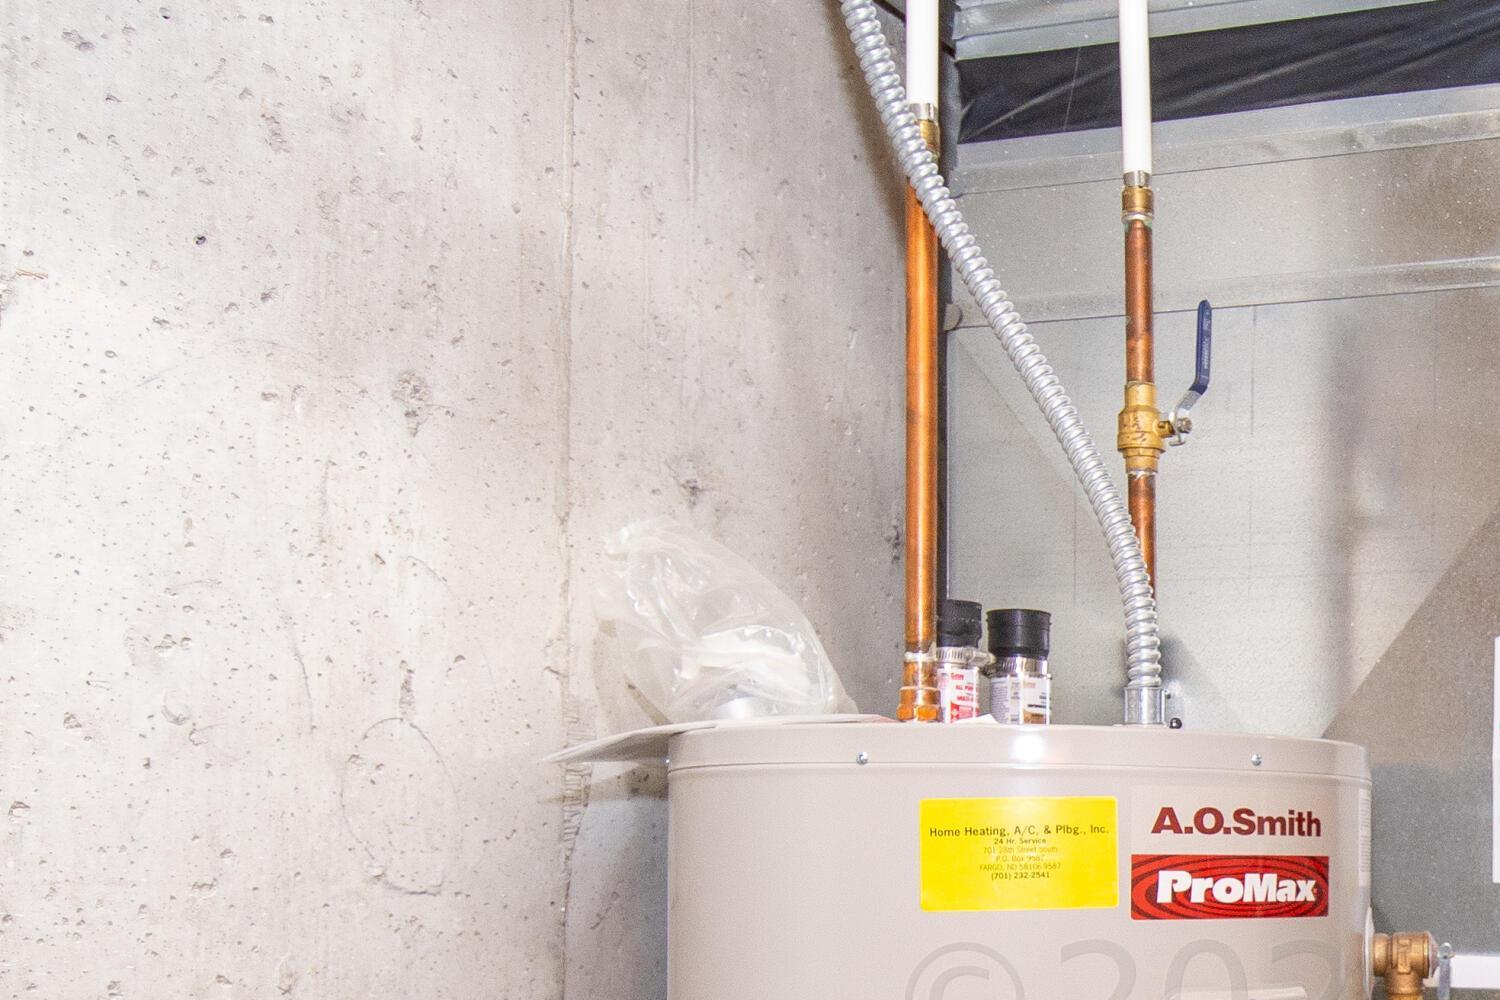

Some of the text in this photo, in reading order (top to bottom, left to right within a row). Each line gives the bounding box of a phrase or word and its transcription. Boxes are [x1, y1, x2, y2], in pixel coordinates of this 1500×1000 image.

[1151, 806, 1322, 837] A.O.Smith
[929, 827, 960, 837] Home
[965, 826, 1010, 838] Heating,
[1014, 825, 1039, 837] A/C,
[1043, 824, 1052, 835] &
[1090, 824, 1110, 834] Inc.
[1019, 837, 1047, 845] Service
[991, 871, 1050, 880] (701) 232-2541
[1156, 870, 1316, 904] ProMax
